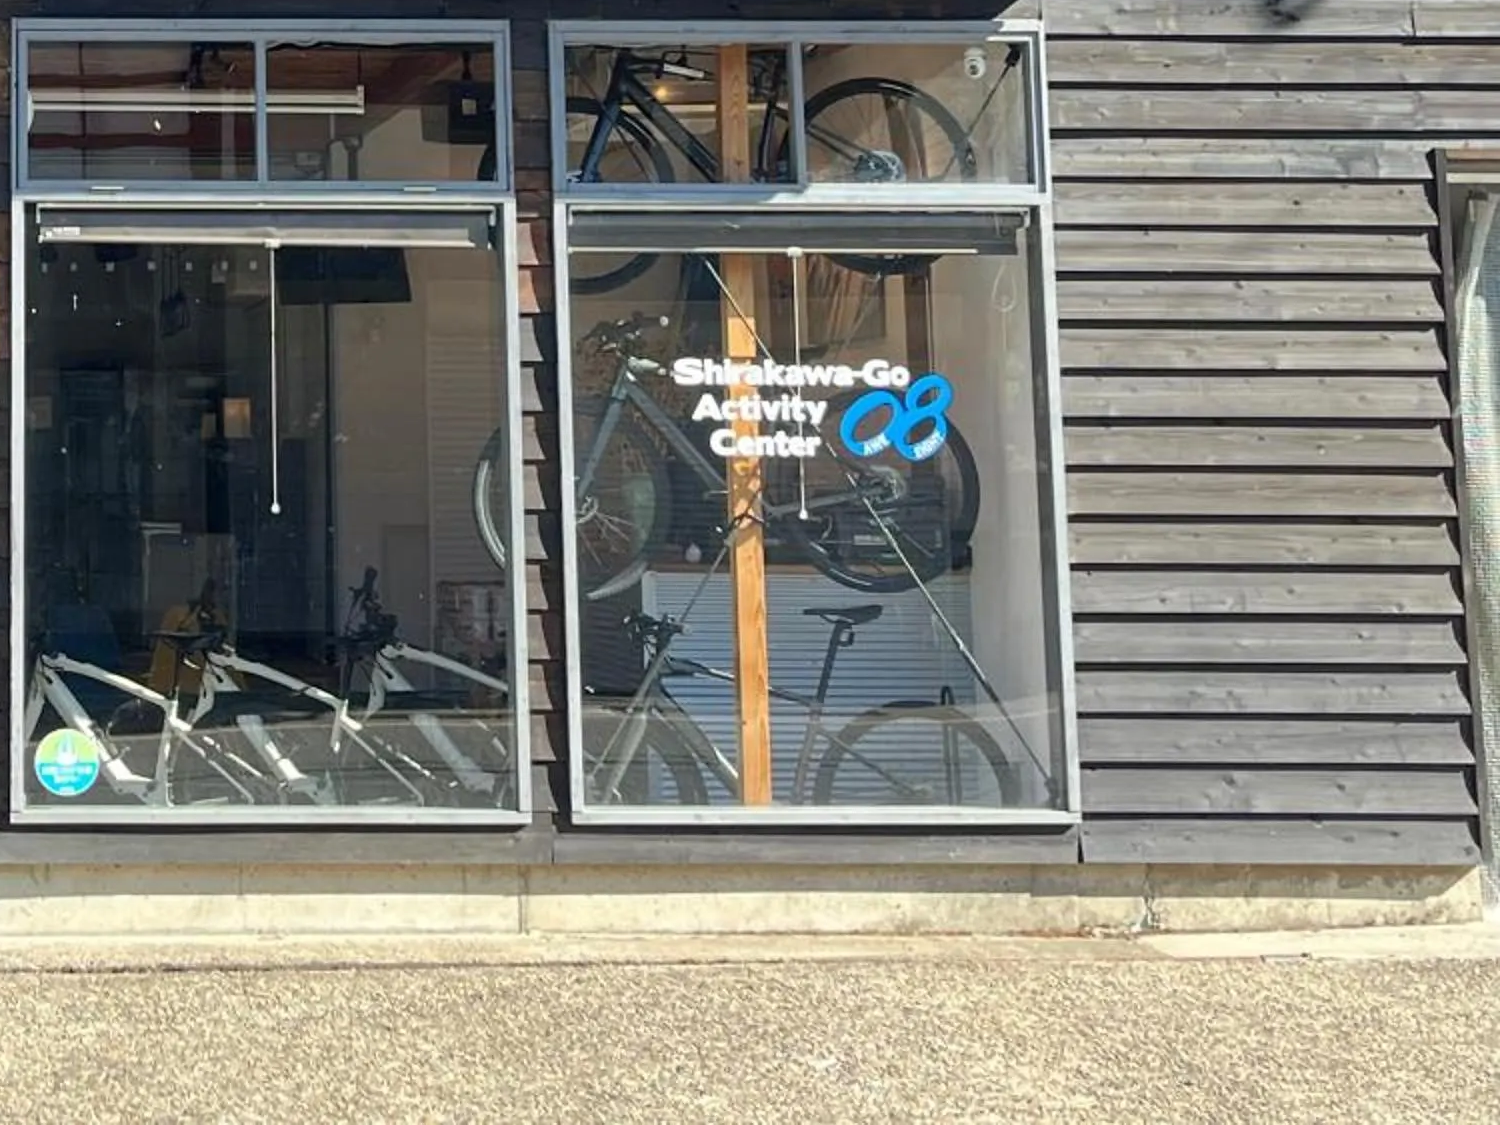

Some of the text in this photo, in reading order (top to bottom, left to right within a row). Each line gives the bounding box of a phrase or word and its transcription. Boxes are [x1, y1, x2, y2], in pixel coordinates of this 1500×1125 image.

[672, 357, 911, 387] Shirakawa-Go
[691, 393, 828, 425] Activity
[708, 428, 822, 457] Center
